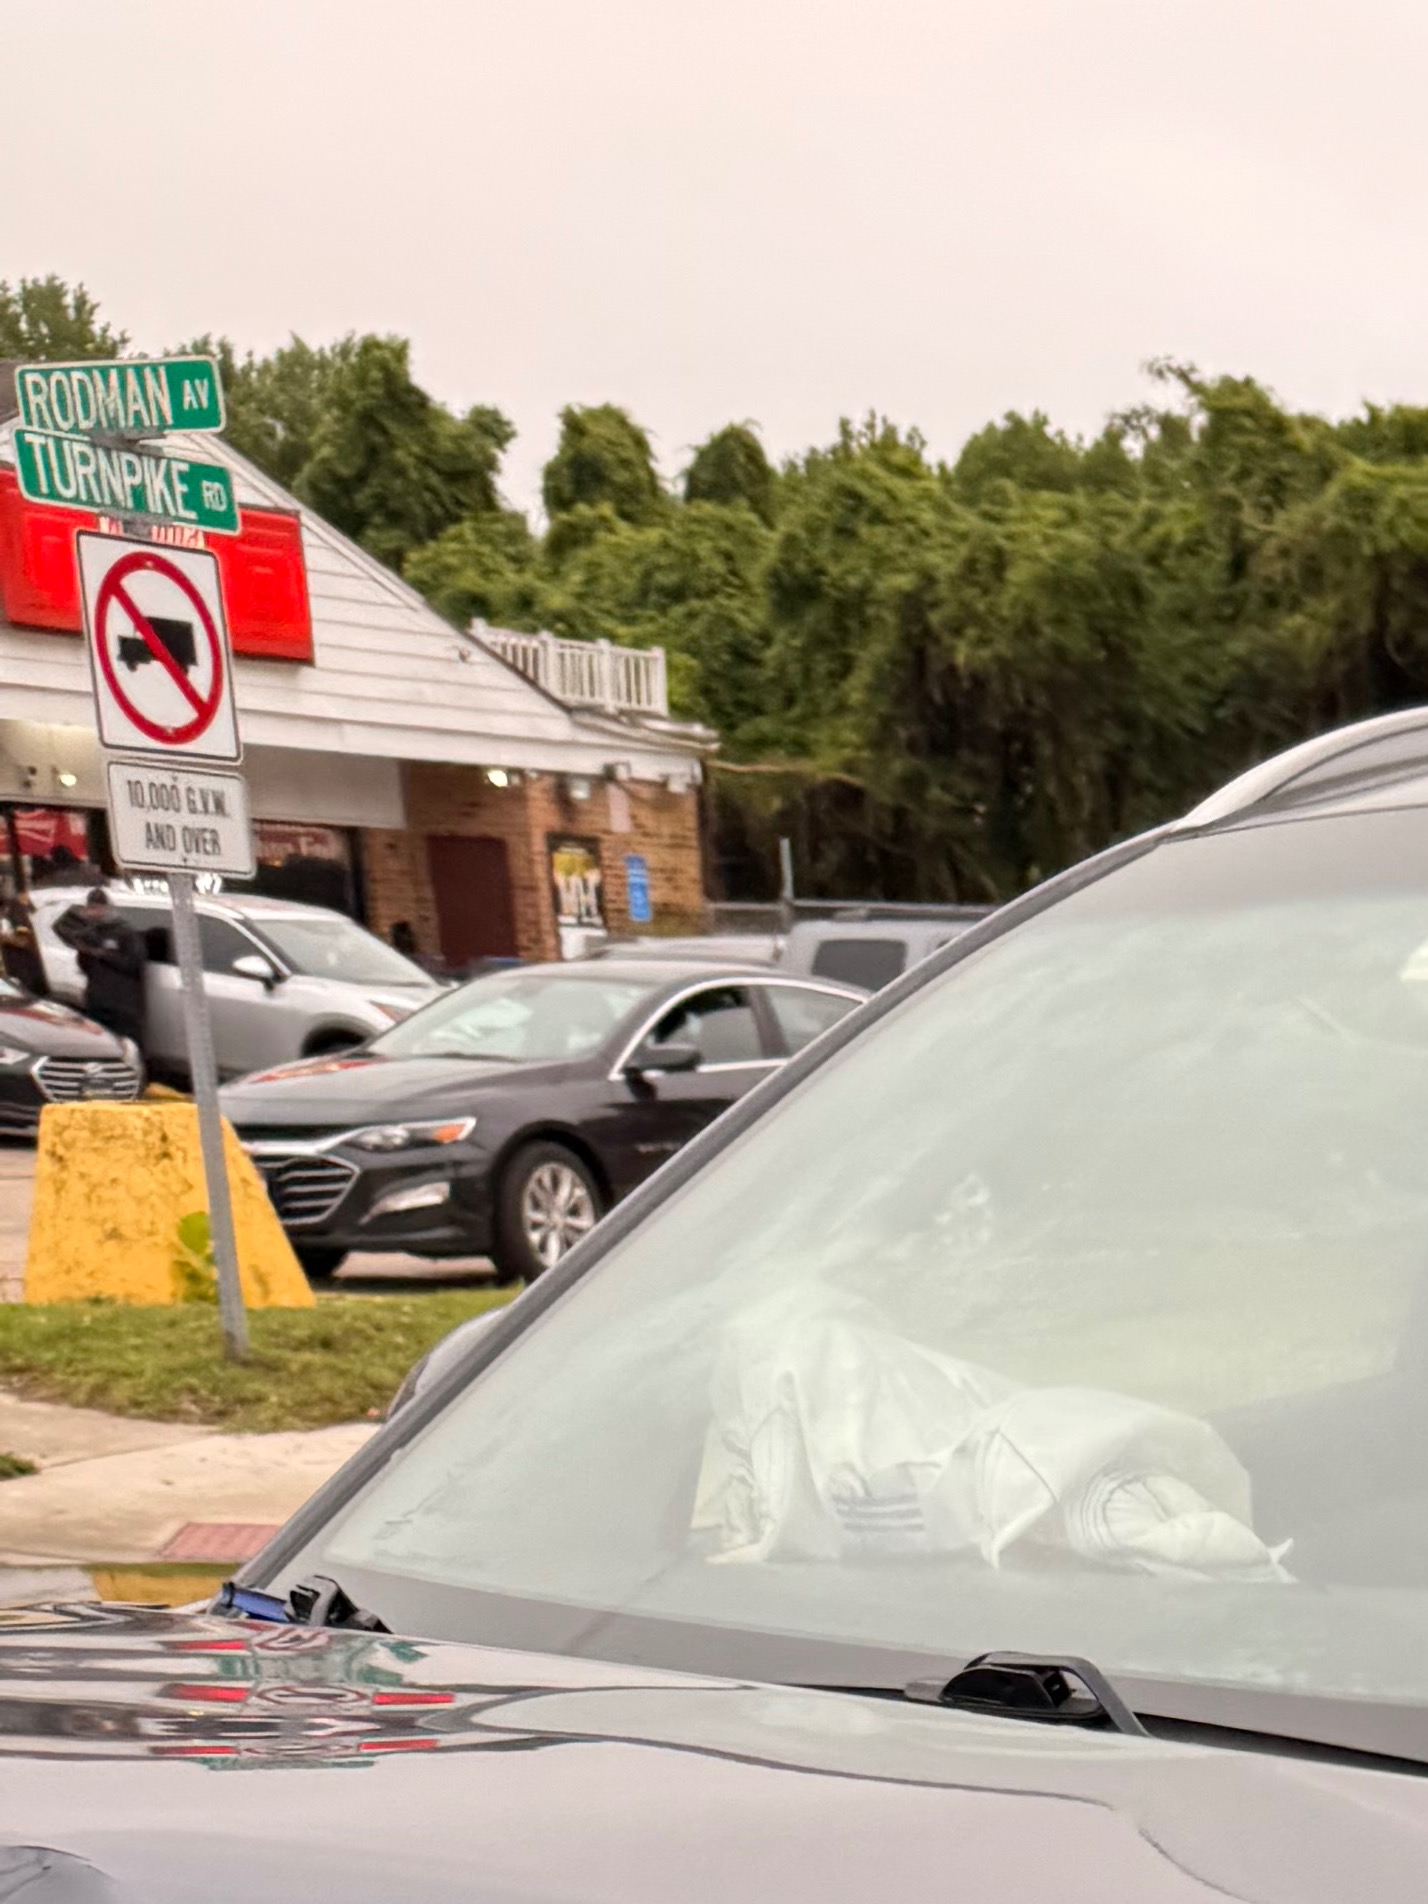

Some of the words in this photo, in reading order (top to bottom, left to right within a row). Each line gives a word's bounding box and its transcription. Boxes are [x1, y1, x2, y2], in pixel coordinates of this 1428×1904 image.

[24, 365, 174, 431] RODMAN
[183, 378, 209, 411] AV
[24, 433, 199, 520] TURNPIKE
[202, 480, 228, 512] RD
[127, 780, 182, 813] 10,000
[145, 821, 177, 852] AND
[182, 826, 222, 856] OVER
